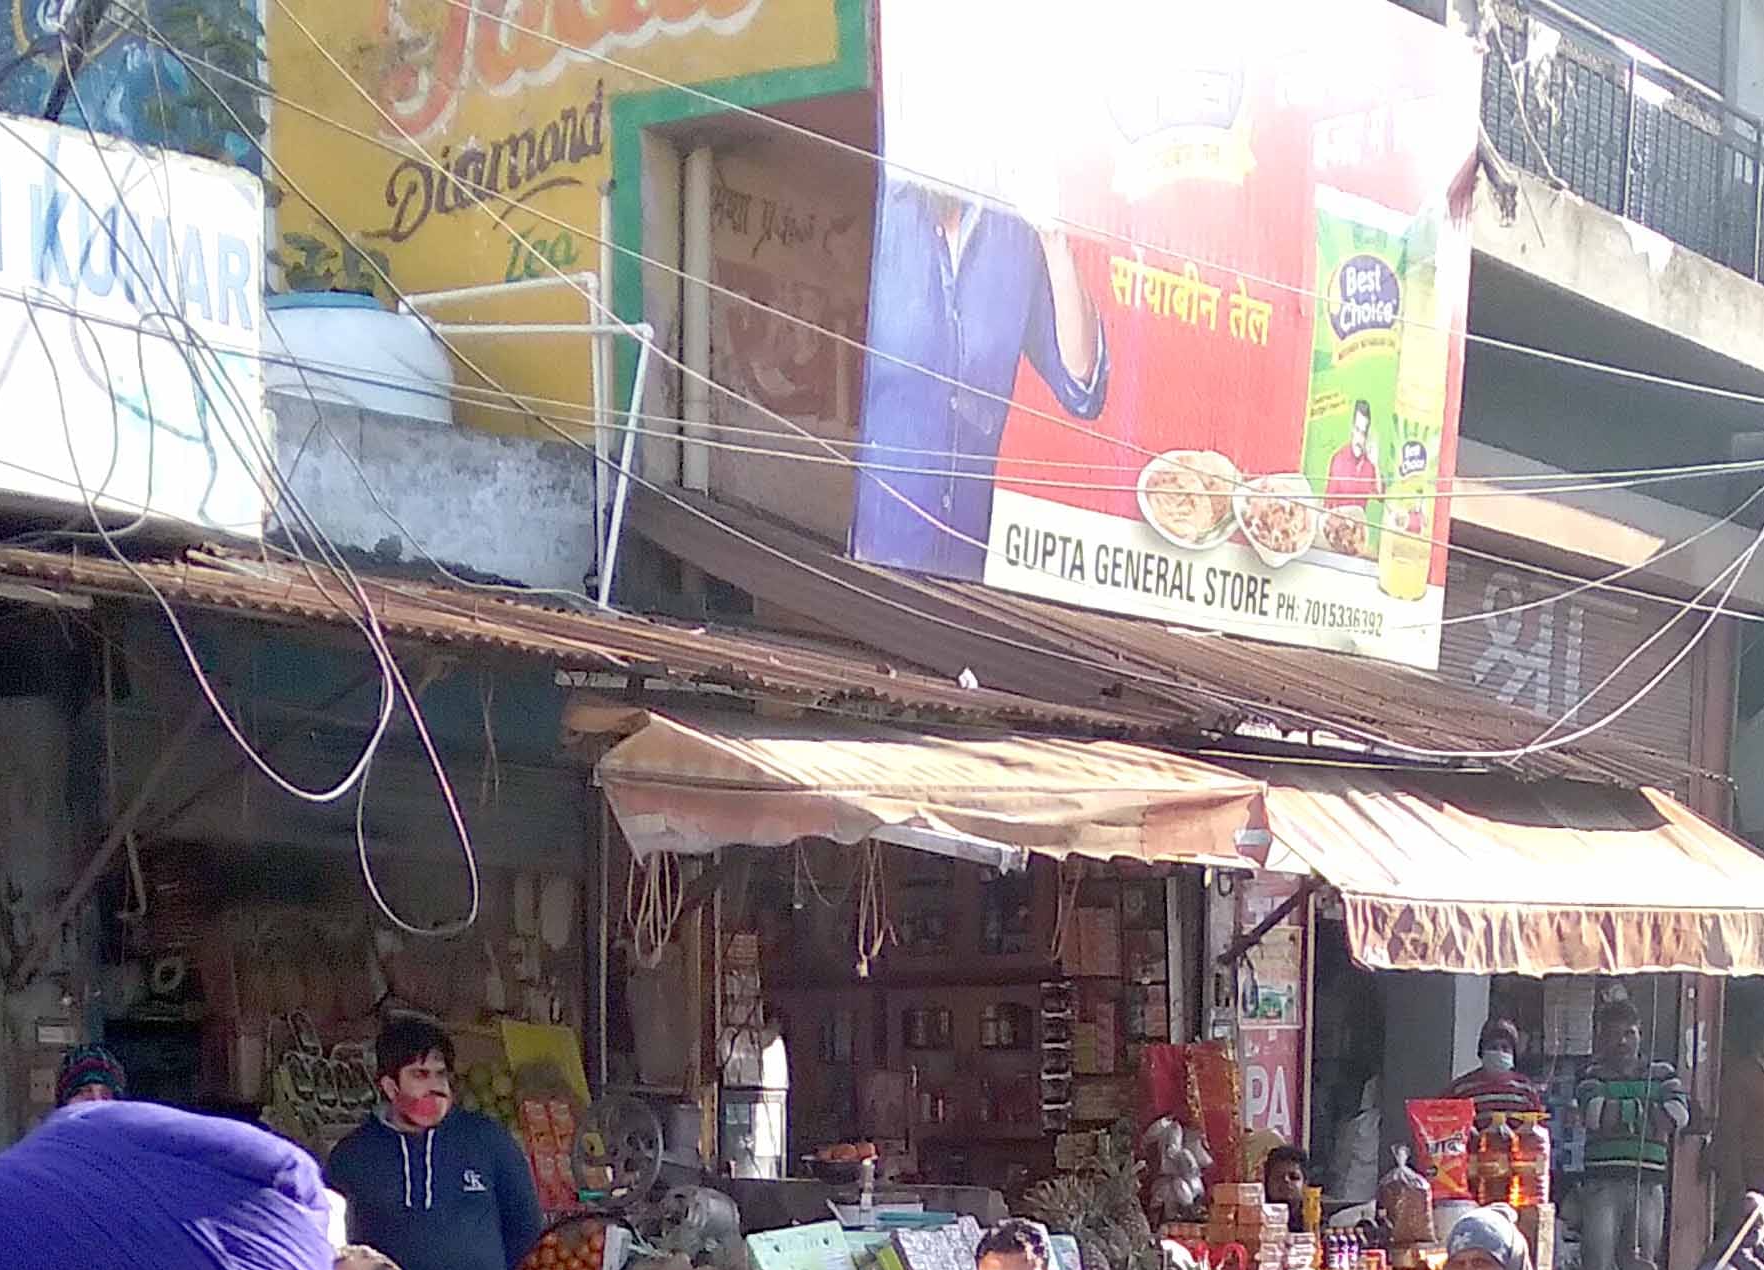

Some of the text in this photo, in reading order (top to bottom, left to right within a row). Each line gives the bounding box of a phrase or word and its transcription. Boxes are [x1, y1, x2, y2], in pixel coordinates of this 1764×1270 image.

[386, 78, 603, 242] Diamond
[29, 182, 253, 330] KUMAR
[1345, 264, 1382, 297] Best
[1005, 523, 1087, 583] GUPTA
[1094, 550, 1197, 604] GENERAL
[1204, 567, 1272, 617] STORE
